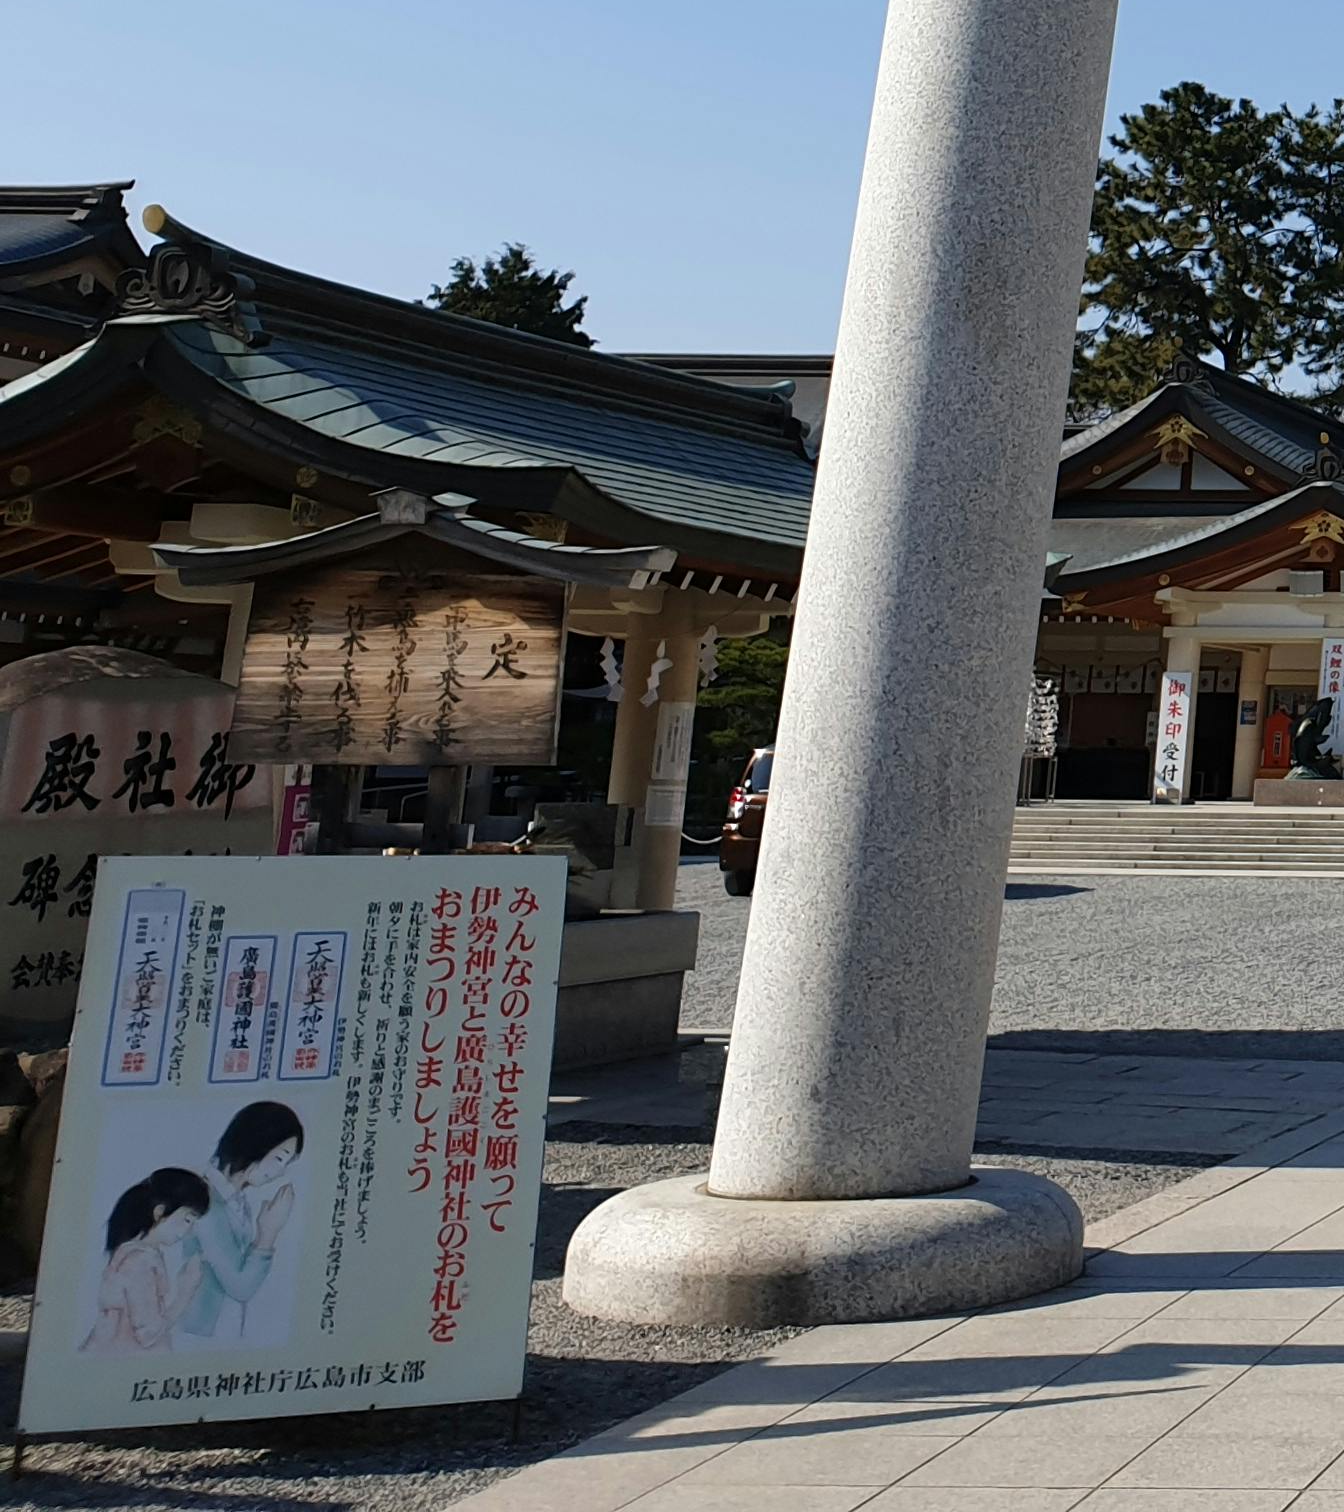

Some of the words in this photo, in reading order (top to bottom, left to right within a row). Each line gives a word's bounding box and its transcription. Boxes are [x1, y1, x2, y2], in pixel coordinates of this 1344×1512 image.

[481, 633, 528, 681] 定
[1162, 679, 1186, 782] 御朱印受付
[407, 886, 463, 1194] おまつりしましょう
[427, 886, 501, 1343] 伊勢神宮と廣島護國神社のお札を
[480, 886, 540, 1233] みんなの幸せを願って
[129, 1360, 427, 1402] 広島県神社庁広島市支部
